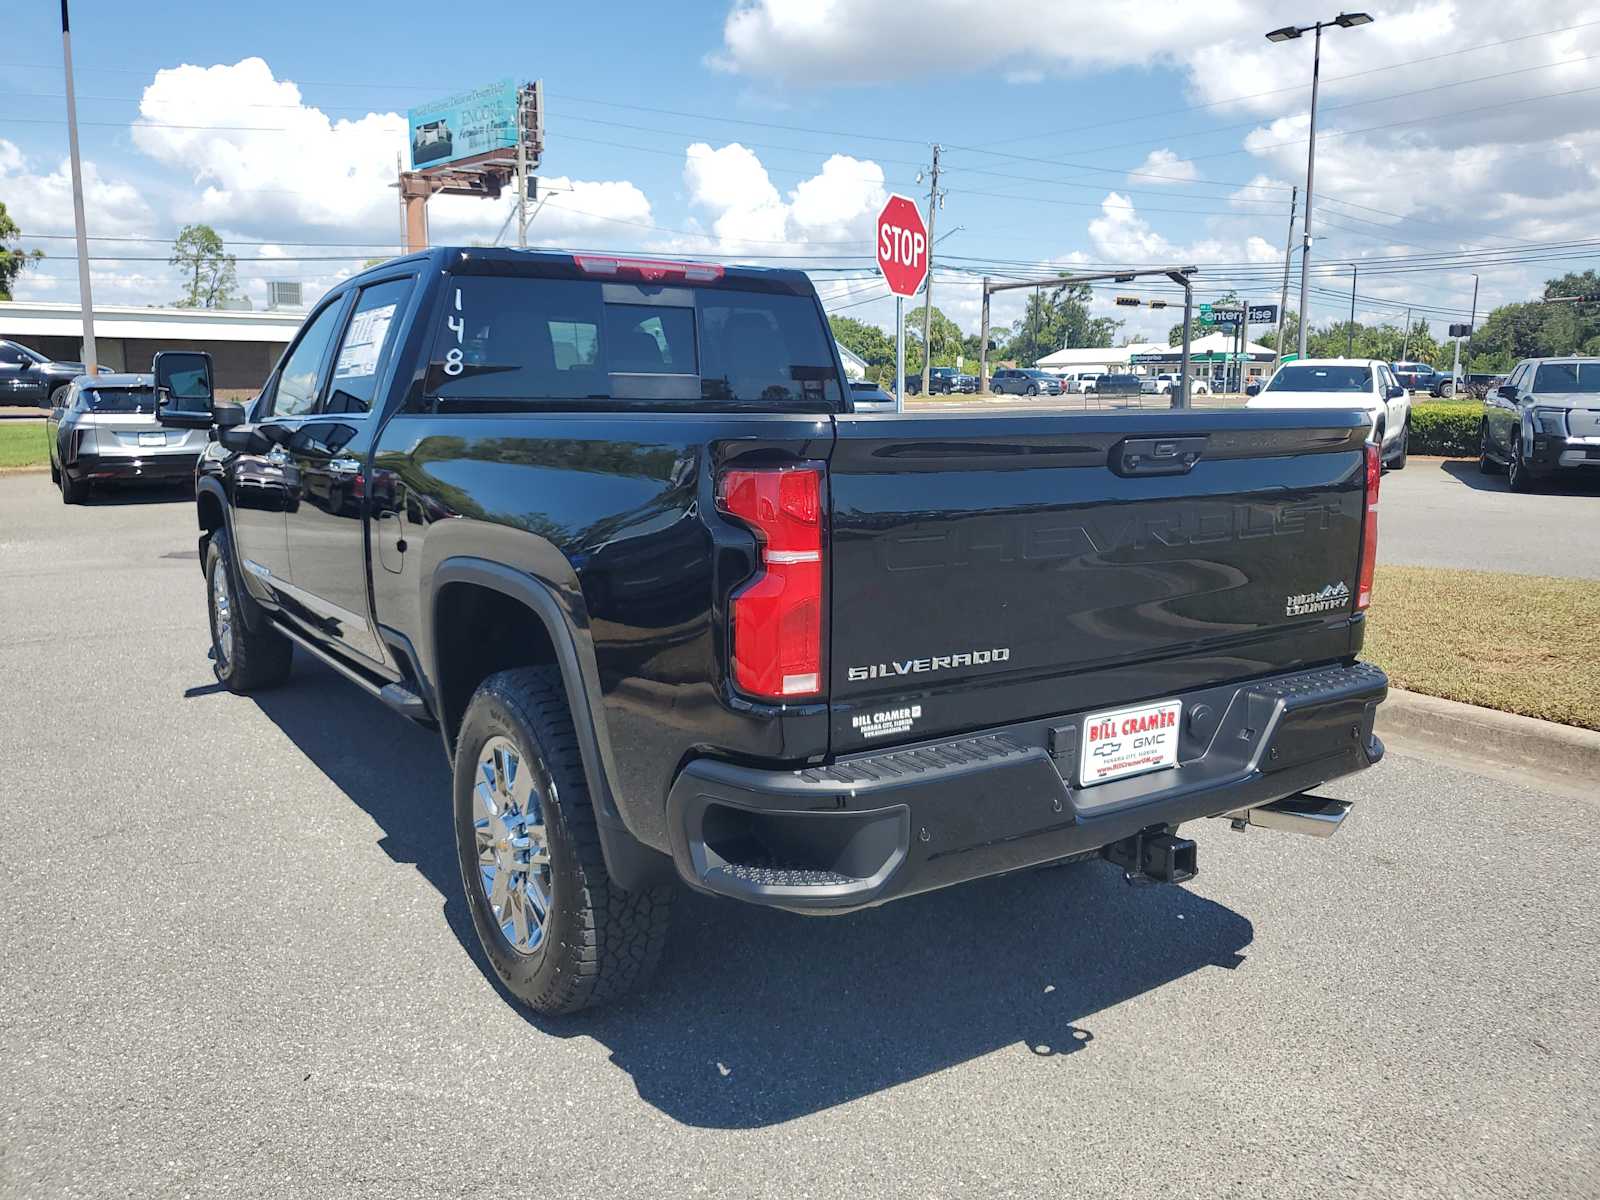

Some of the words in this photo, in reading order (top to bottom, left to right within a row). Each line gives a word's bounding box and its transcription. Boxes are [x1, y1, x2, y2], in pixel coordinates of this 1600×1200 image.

[880, 223, 925, 268] STOP
[886, 502, 1343, 571] CHEVROLET
[1286, 597, 1349, 617] COUNTRY
[1287, 591, 1321, 606] HIGH
[848, 647, 1010, 682] SILVERADO
[852, 714, 872, 728] BILL
[873, 708, 911, 724] CRAMER
[1089, 722, 1117, 742] BILL
[1121, 712, 1175, 735] CRAMER
[1133, 734, 1166, 749] GMC
